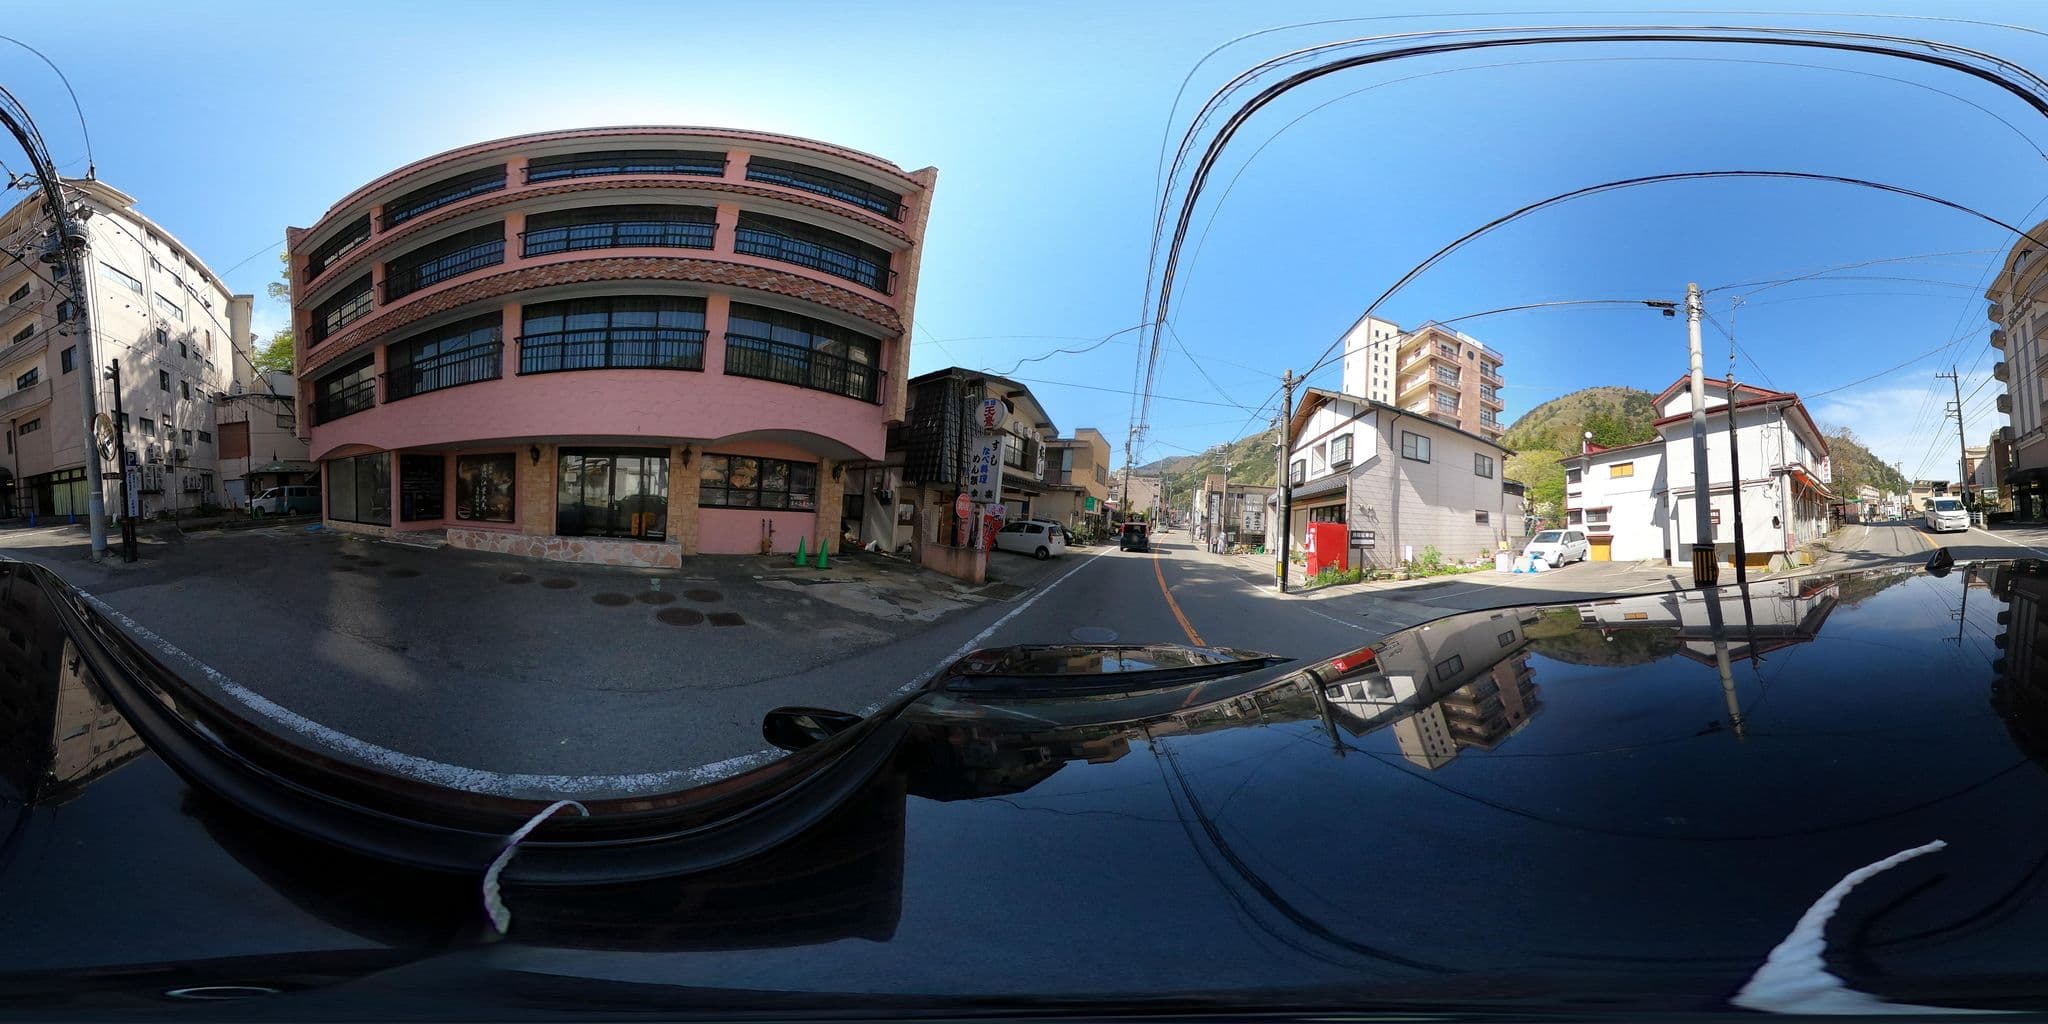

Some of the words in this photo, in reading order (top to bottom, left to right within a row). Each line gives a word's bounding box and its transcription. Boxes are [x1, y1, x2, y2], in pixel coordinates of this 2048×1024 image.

[979, 446, 991, 484] なべ料理
[990, 439, 1000, 466] すし
